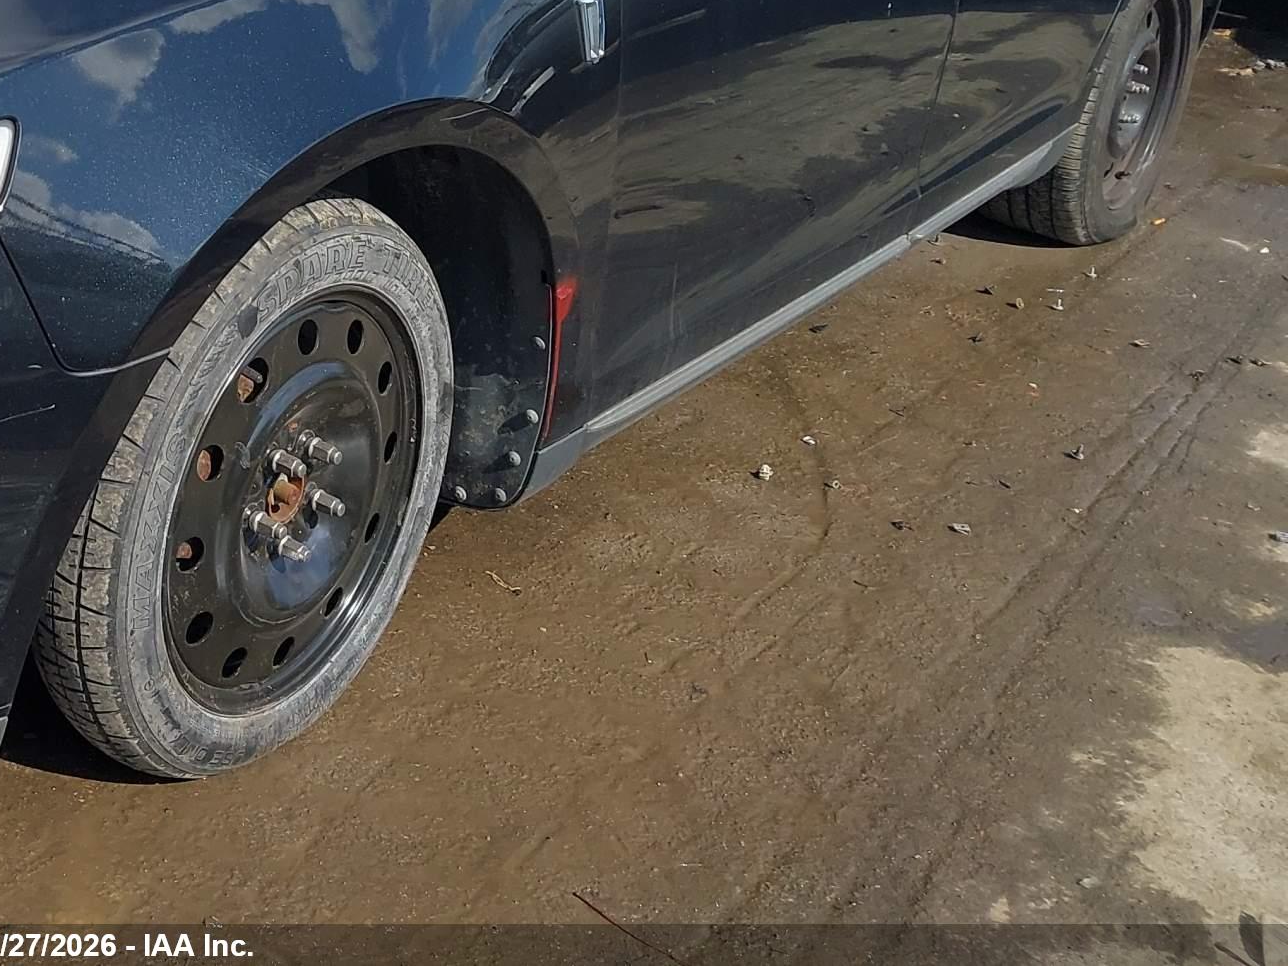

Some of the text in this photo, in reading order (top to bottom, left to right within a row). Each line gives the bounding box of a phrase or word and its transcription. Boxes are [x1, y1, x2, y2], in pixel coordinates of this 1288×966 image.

[256, 238, 435, 318] SPARE TIRE
[132, 432, 187, 631] MAXXIS
